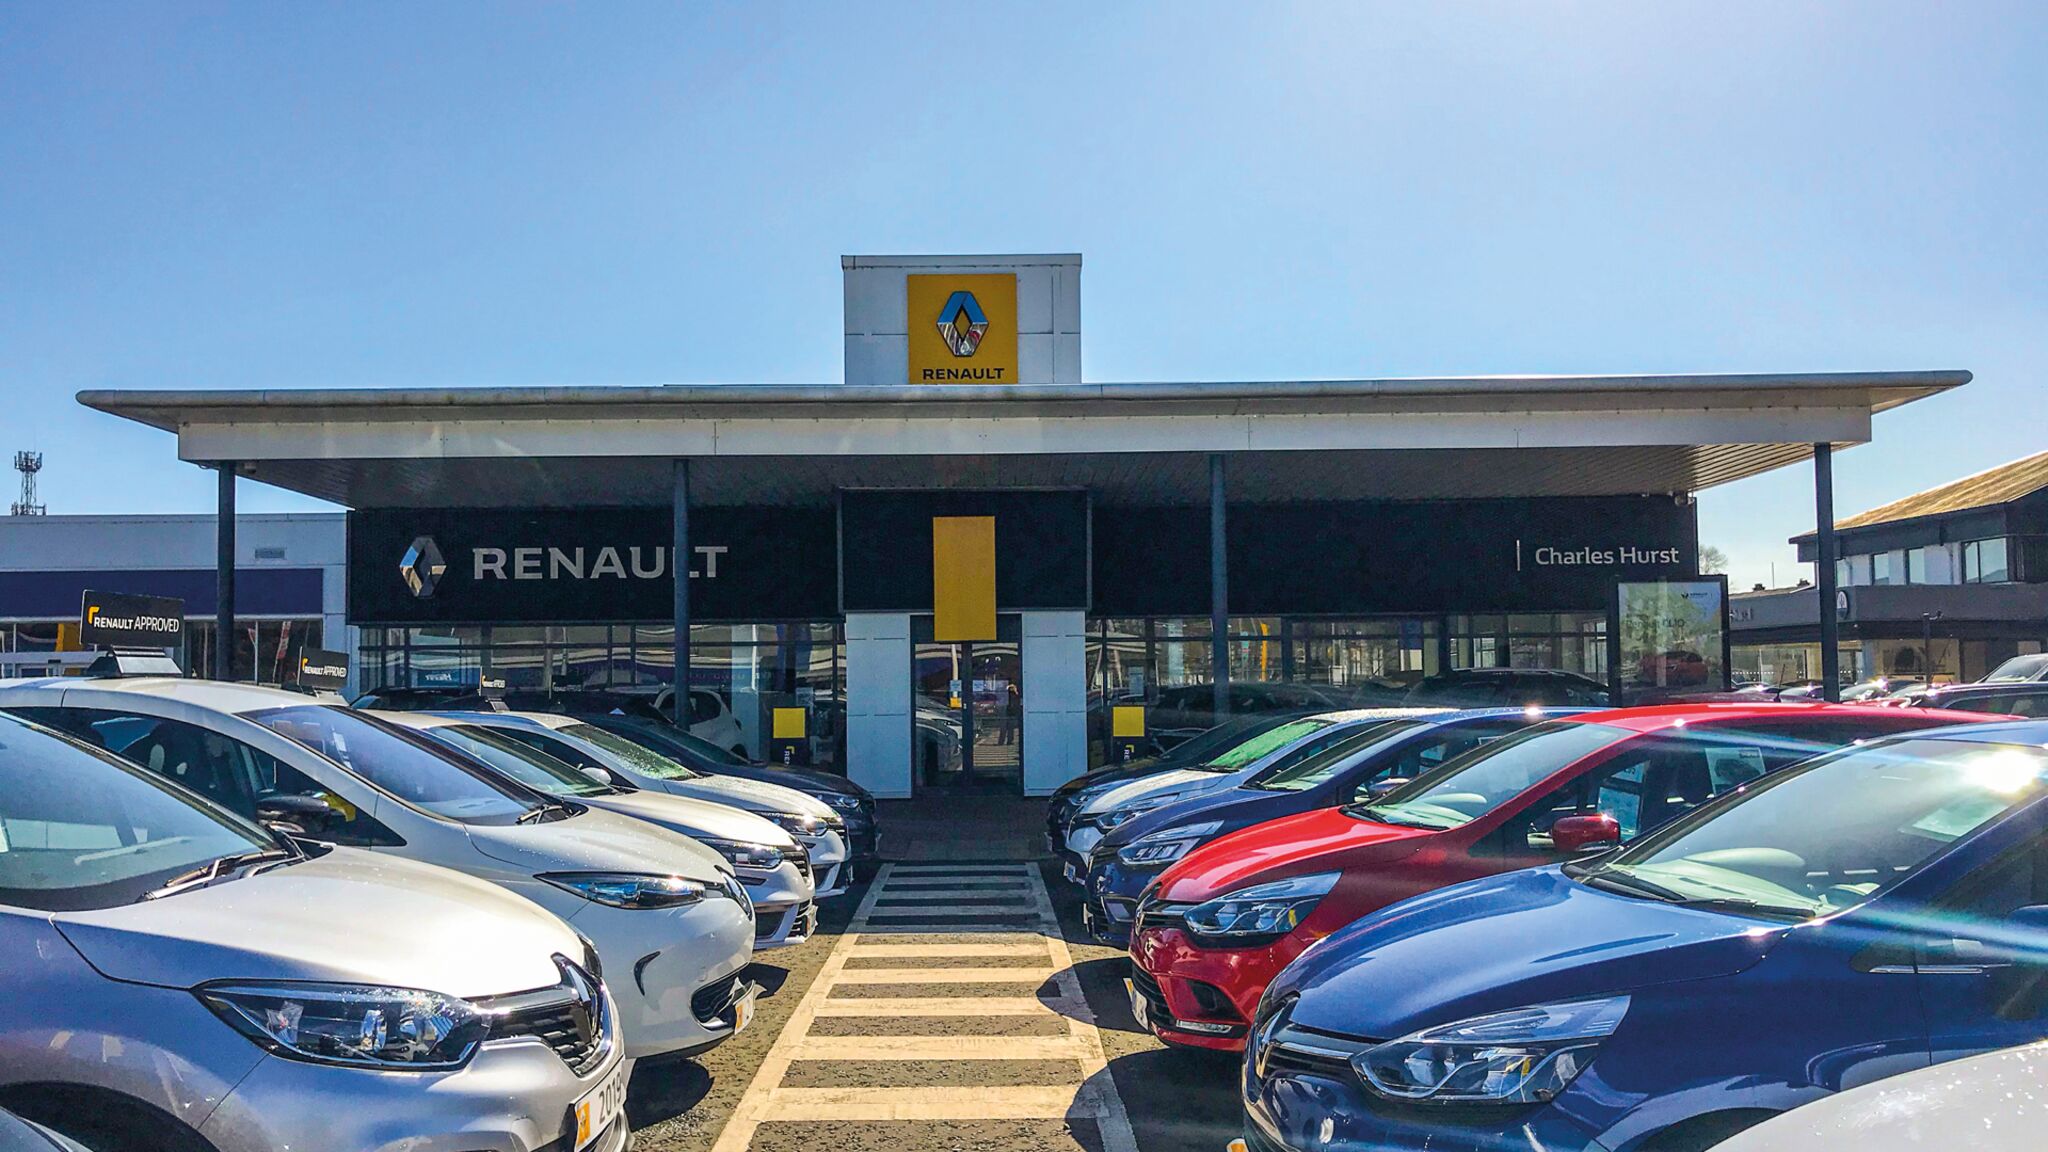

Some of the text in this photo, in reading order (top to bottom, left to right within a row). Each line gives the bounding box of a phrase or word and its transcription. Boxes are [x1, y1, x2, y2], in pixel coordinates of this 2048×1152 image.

[922, 368, 1005, 380] RENAULT
[1535, 547, 1680, 565] Charles Hurst
[93, 615, 180, 633] RENAULT APPROVED
[598, 1071, 622, 1125] 2019
